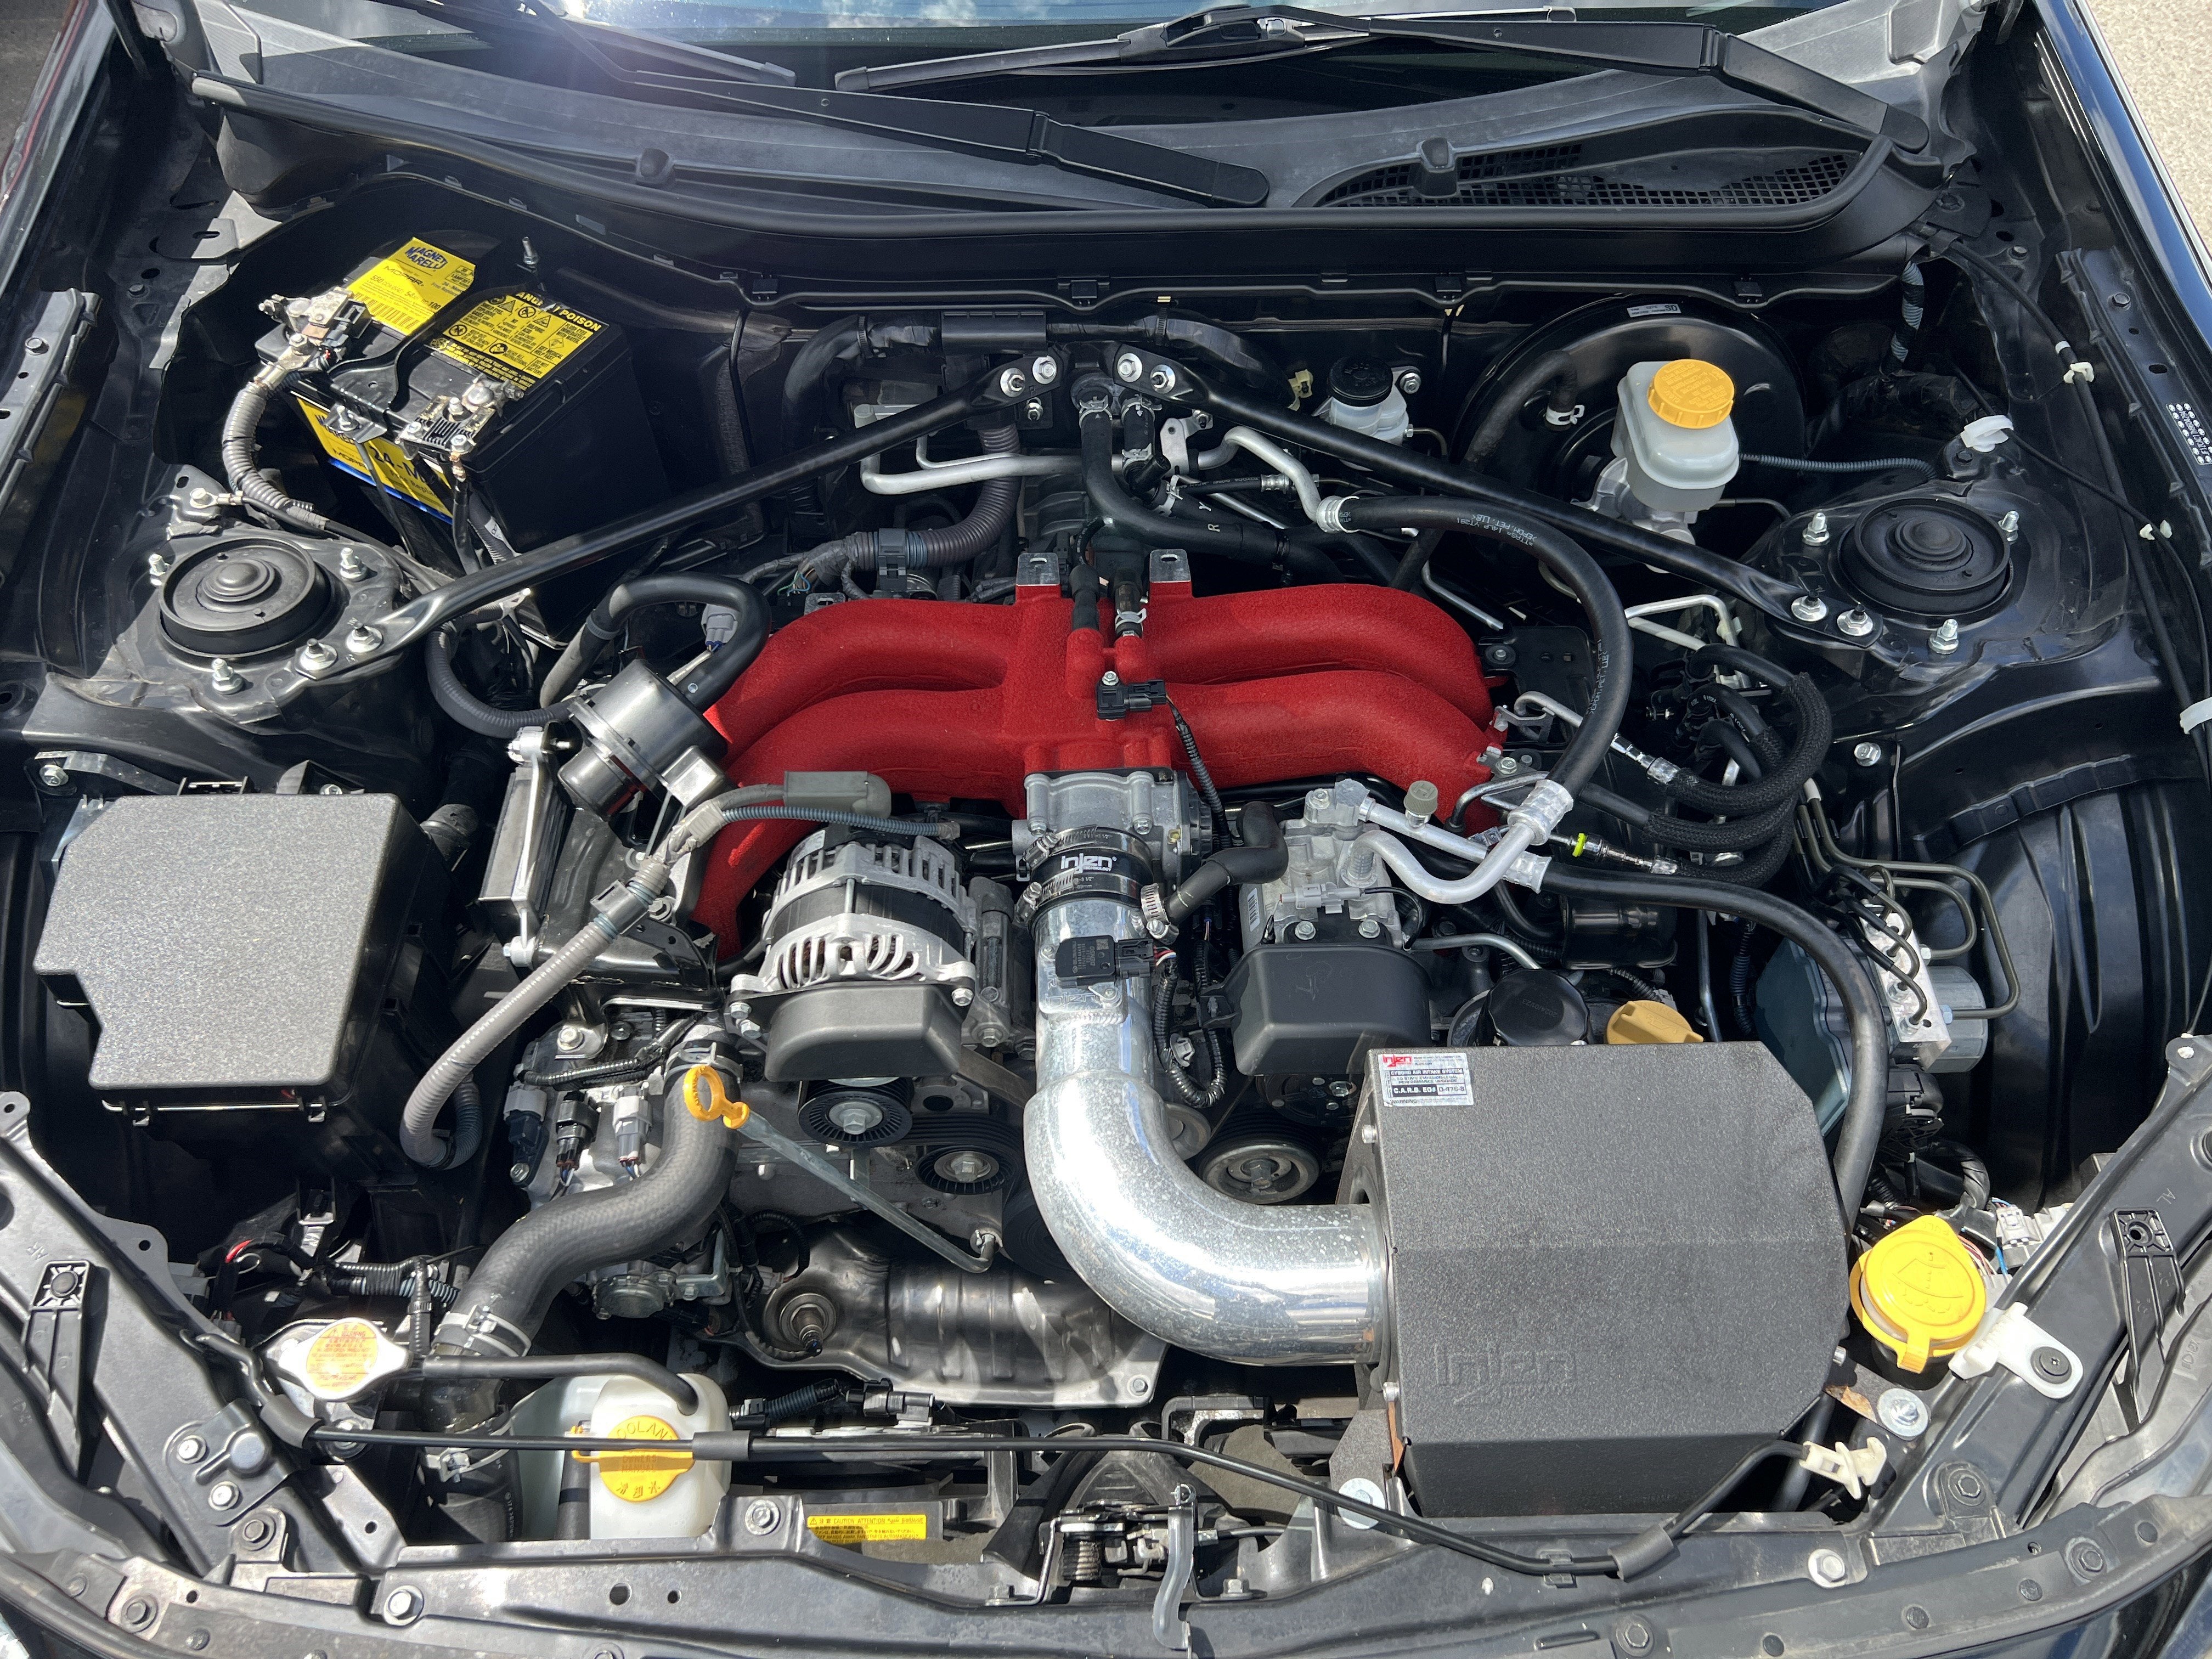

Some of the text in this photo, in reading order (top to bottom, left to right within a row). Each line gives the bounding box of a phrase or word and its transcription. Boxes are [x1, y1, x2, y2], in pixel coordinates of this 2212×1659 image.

[383, 266, 424, 287] MOPAR
[428, 301, 442, 310] 100
[559, 309, 602, 331] POISON
[1208, 523, 1220, 532] R
[1383, 1054, 1412, 1068] injen
